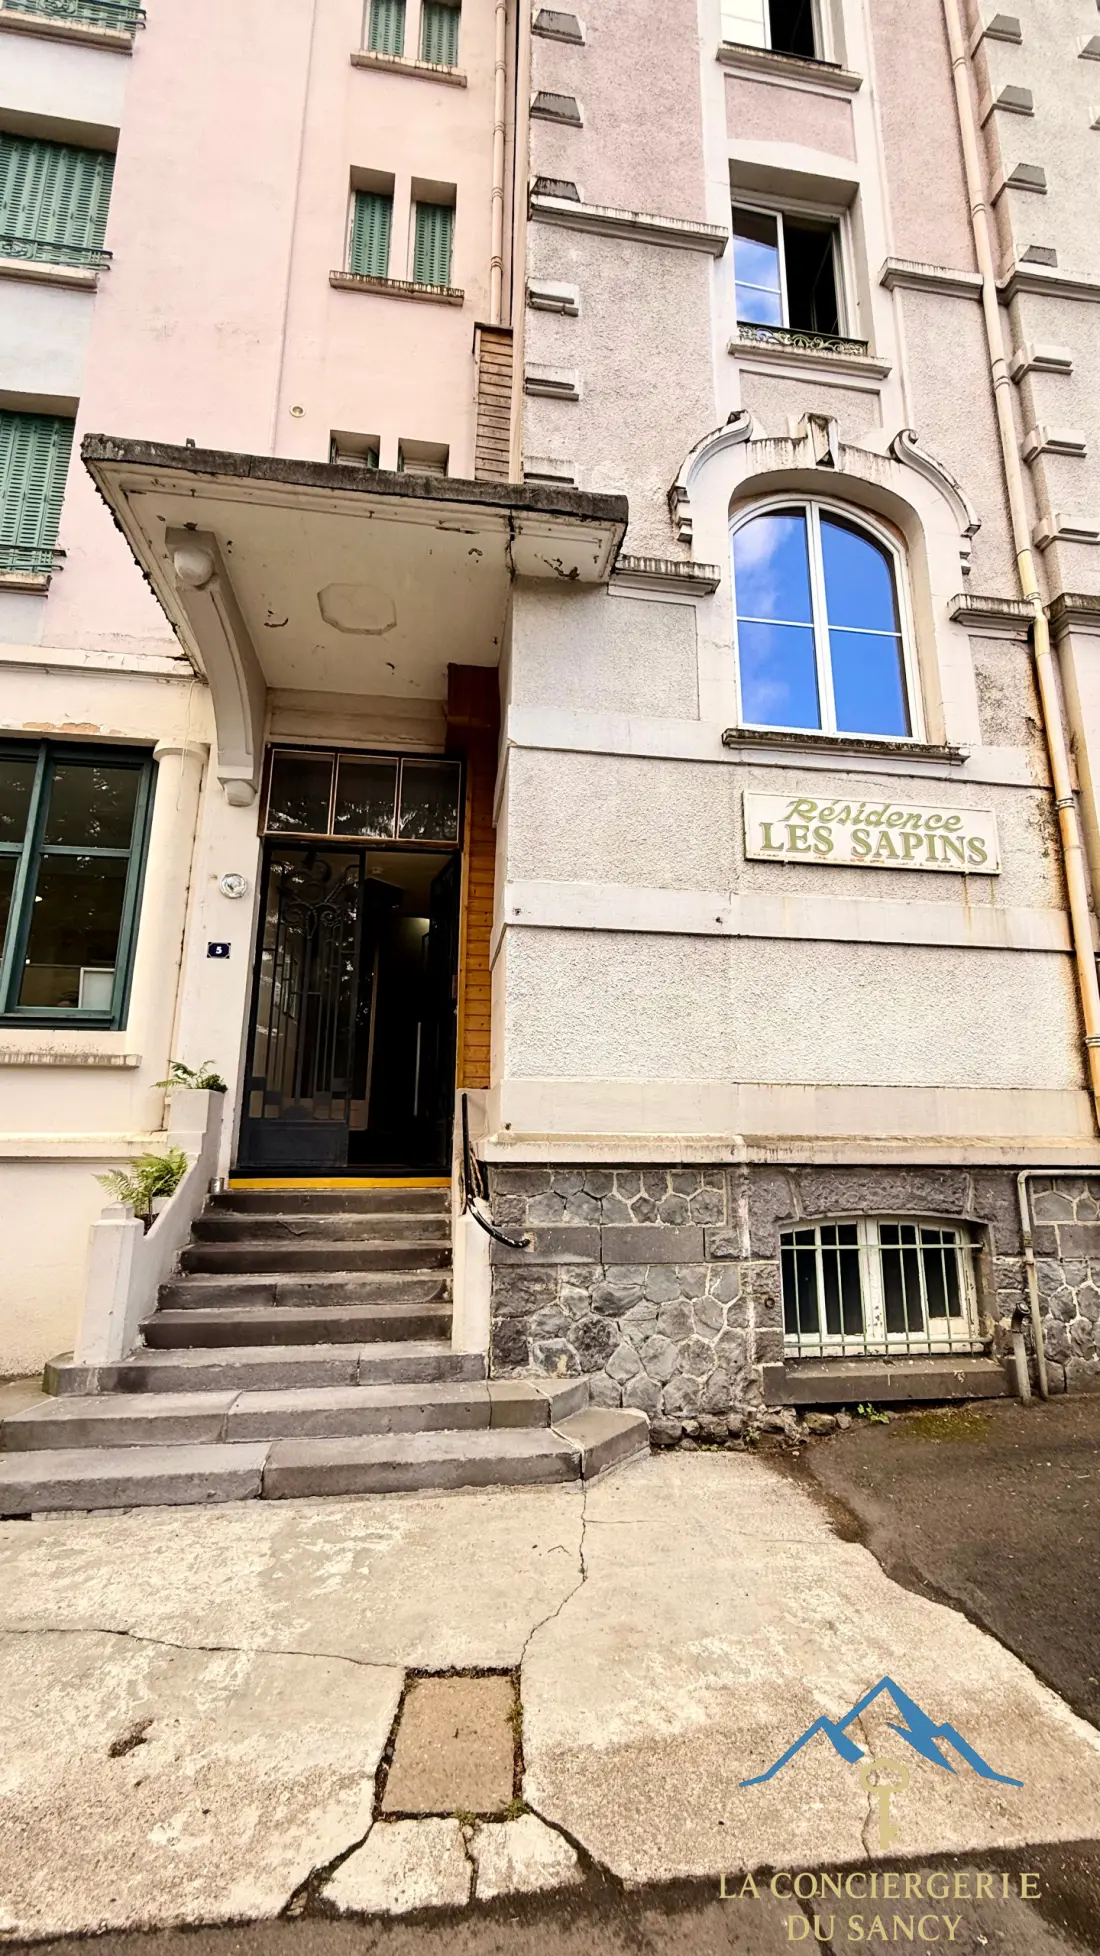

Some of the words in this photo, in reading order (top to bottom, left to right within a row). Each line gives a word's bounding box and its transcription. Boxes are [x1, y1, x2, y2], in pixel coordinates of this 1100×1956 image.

[777, 799, 964, 832] Résidence
[759, 822, 834, 855] LES
[850, 828, 988, 866] SAPINS
[215, 946, 223, 954] 5
